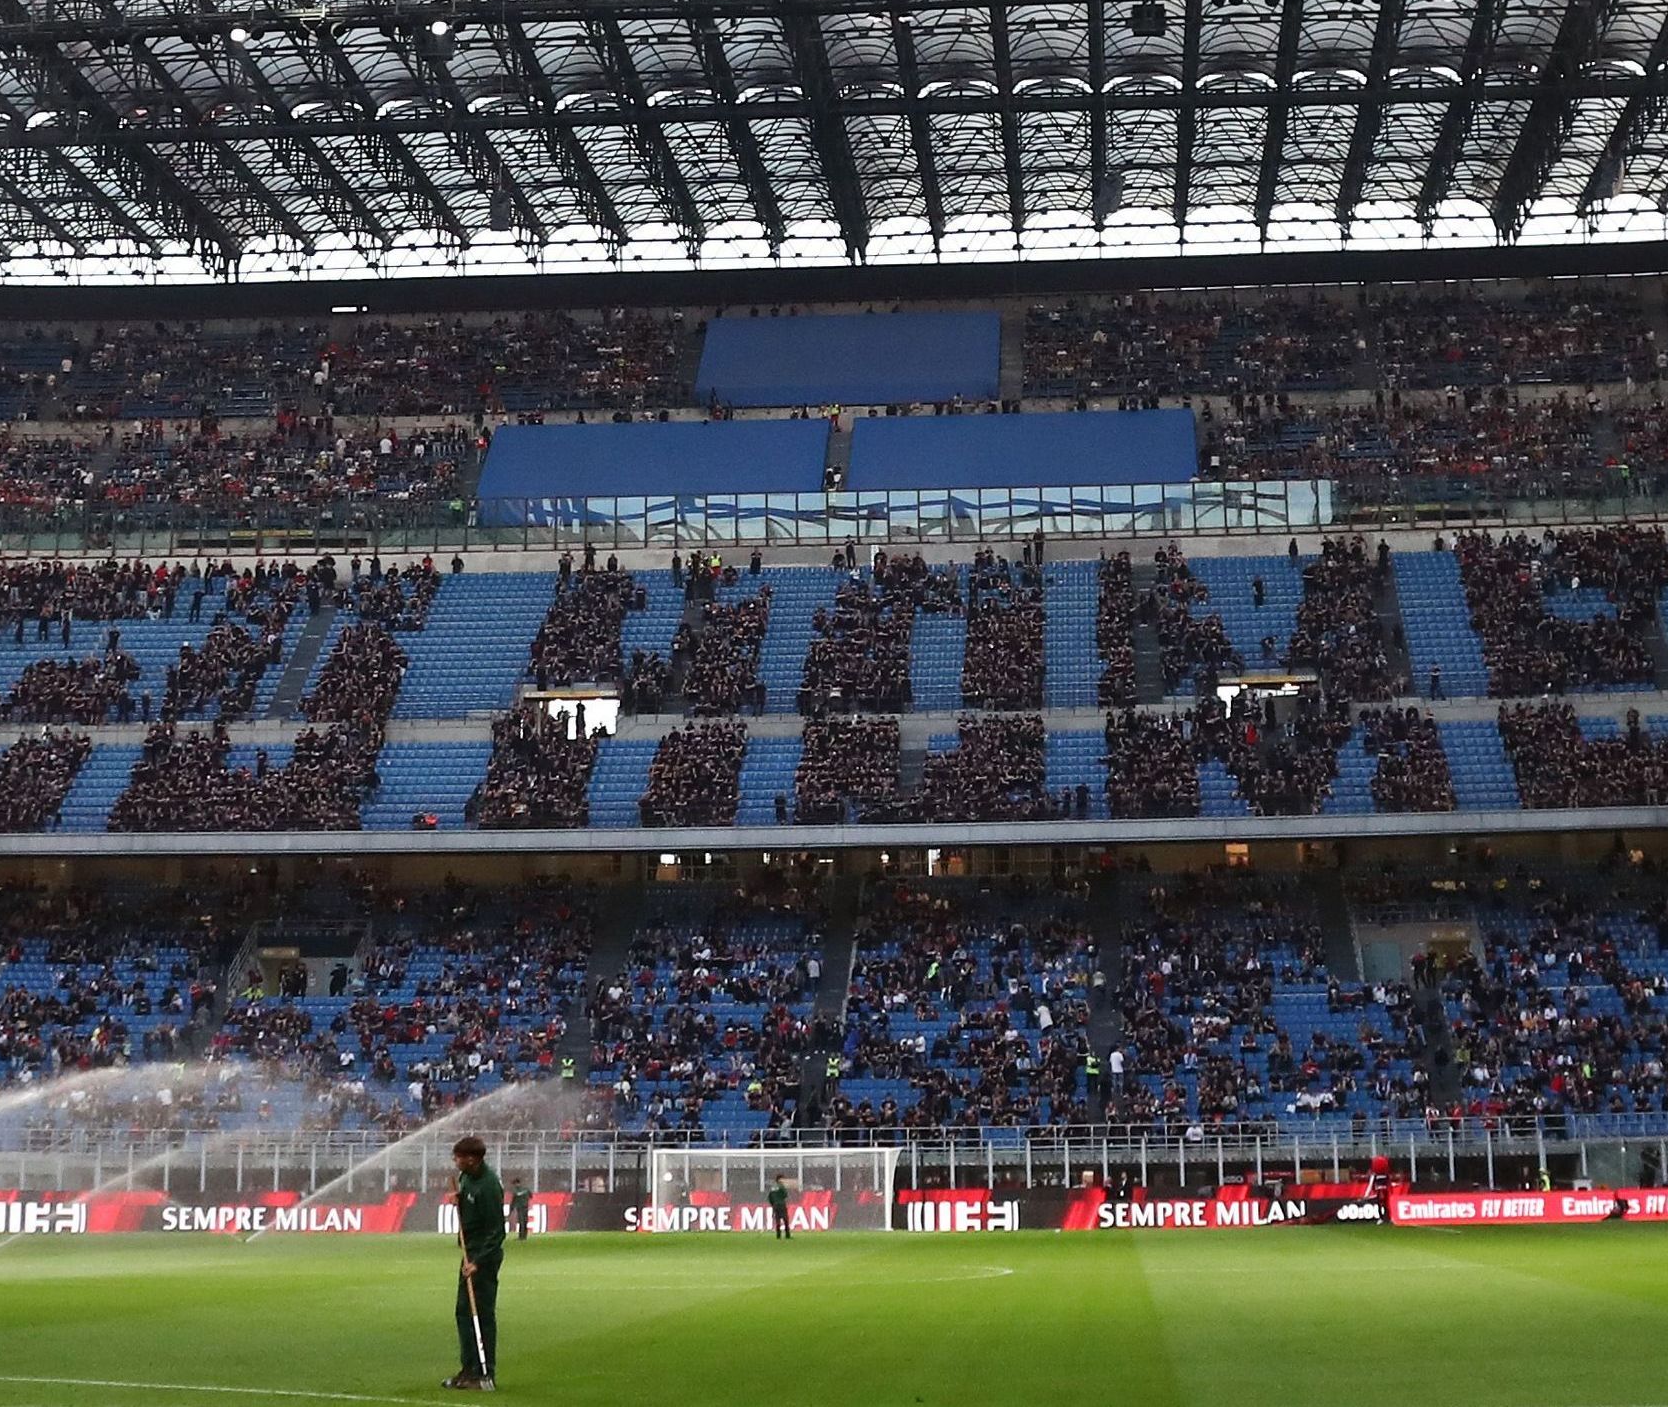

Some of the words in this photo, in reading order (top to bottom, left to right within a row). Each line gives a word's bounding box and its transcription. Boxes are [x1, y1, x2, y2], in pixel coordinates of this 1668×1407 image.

[162, 1207, 267, 1230] SEMPRE
[275, 1207, 362, 1231] MILAN
[624, 1206, 731, 1231] SEMPRE
[741, 1206, 829, 1231] MIAN
[1098, 1201, 1207, 1228] SEMPRE
[1216, 1200, 1306, 1226] MILAN
[1397, 1199, 1476, 1220] Emirates
[1481, 1199, 1502, 1218] FLY
[1503, 1198, 1545, 1217] BETTER
